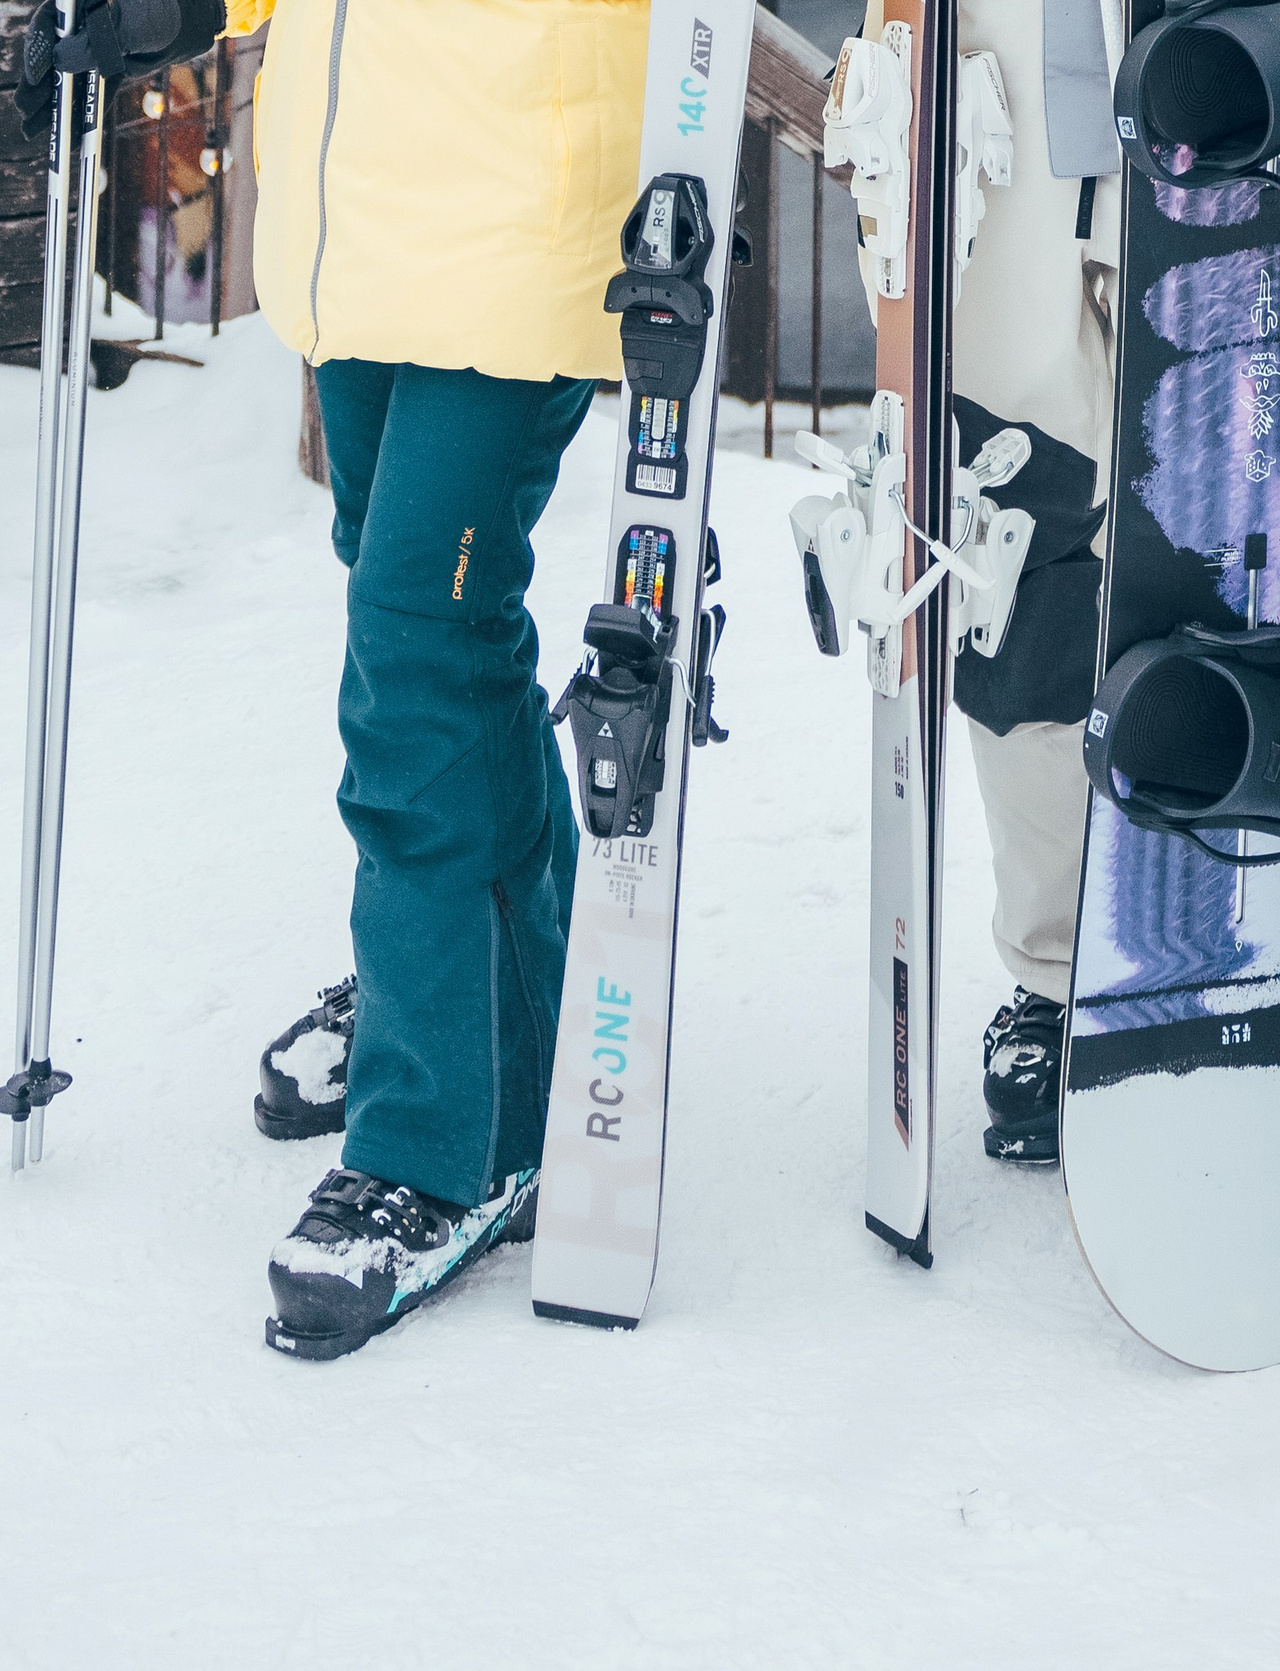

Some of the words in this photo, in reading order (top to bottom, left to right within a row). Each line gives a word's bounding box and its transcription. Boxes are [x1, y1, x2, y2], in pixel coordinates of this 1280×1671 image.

[691, 26, 712, 70] XTR
[620, 841, 658, 867] LITE
[895, 916, 906, 951] 72
[895, 1005, 906, 1064] ONE
[896, 1070, 907, 1108] RC
